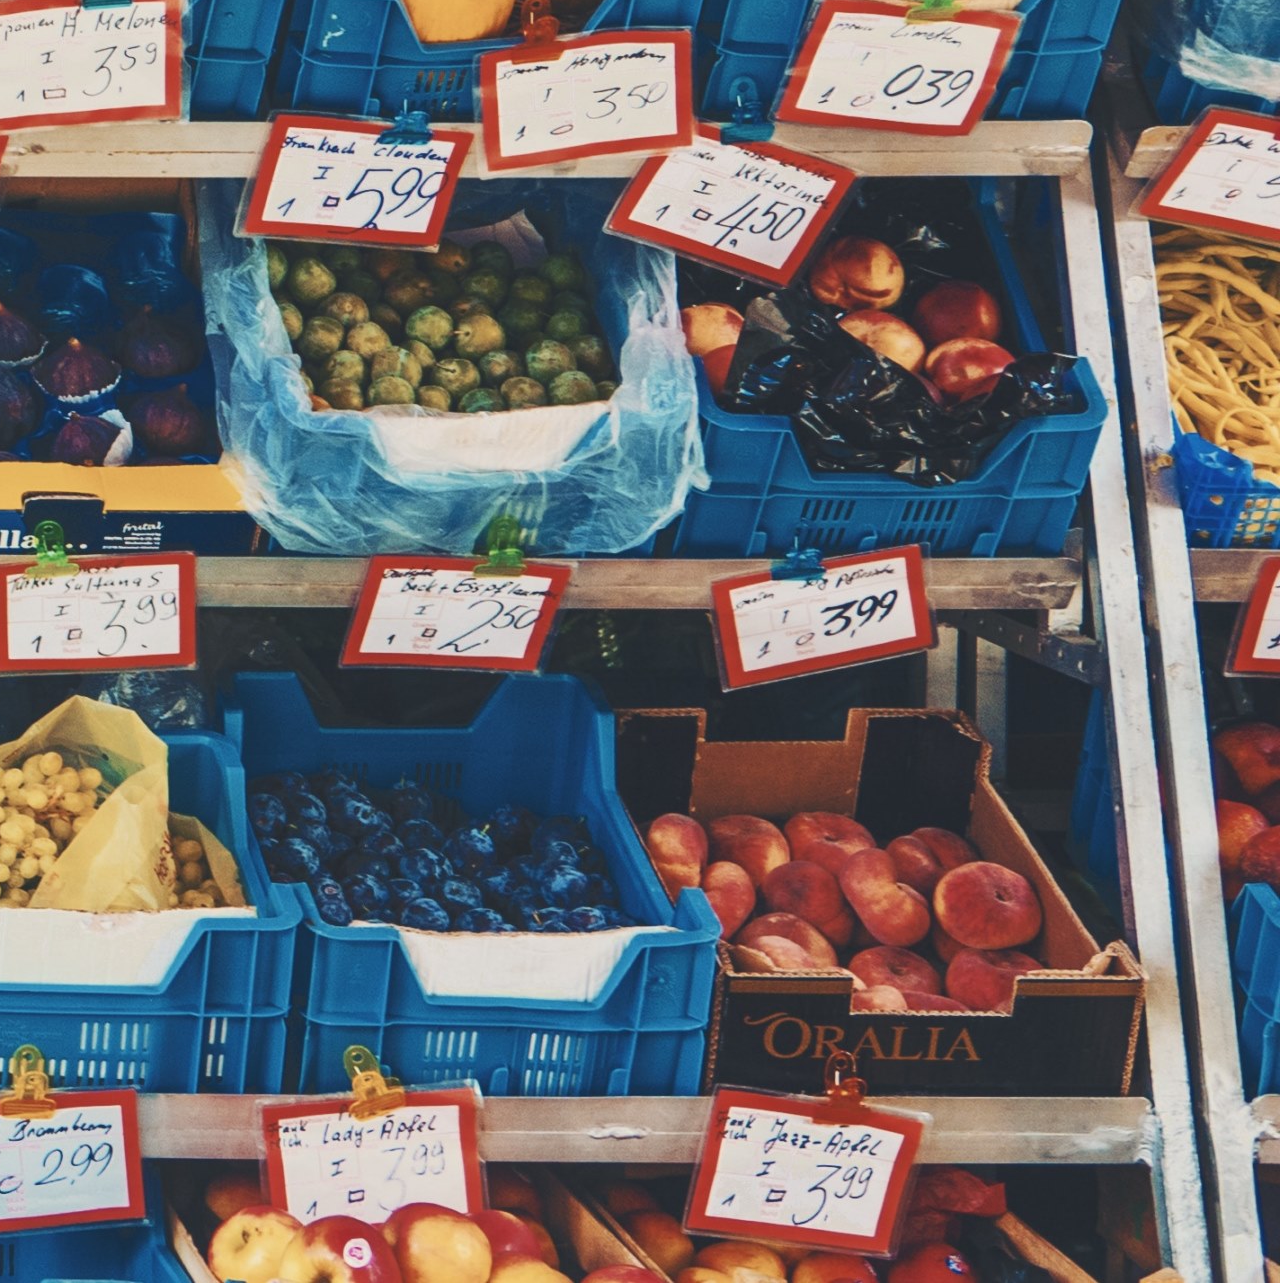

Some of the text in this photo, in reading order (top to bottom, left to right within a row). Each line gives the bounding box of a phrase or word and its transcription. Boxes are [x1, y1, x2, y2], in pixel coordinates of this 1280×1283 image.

[277, 197, 297, 217] 1
[656, 205, 667, 222] 1
[820, 589, 899, 638] 3,99
[31, 636, 42, 653] 1
[744, 1012, 982, 1062] ORALIA
